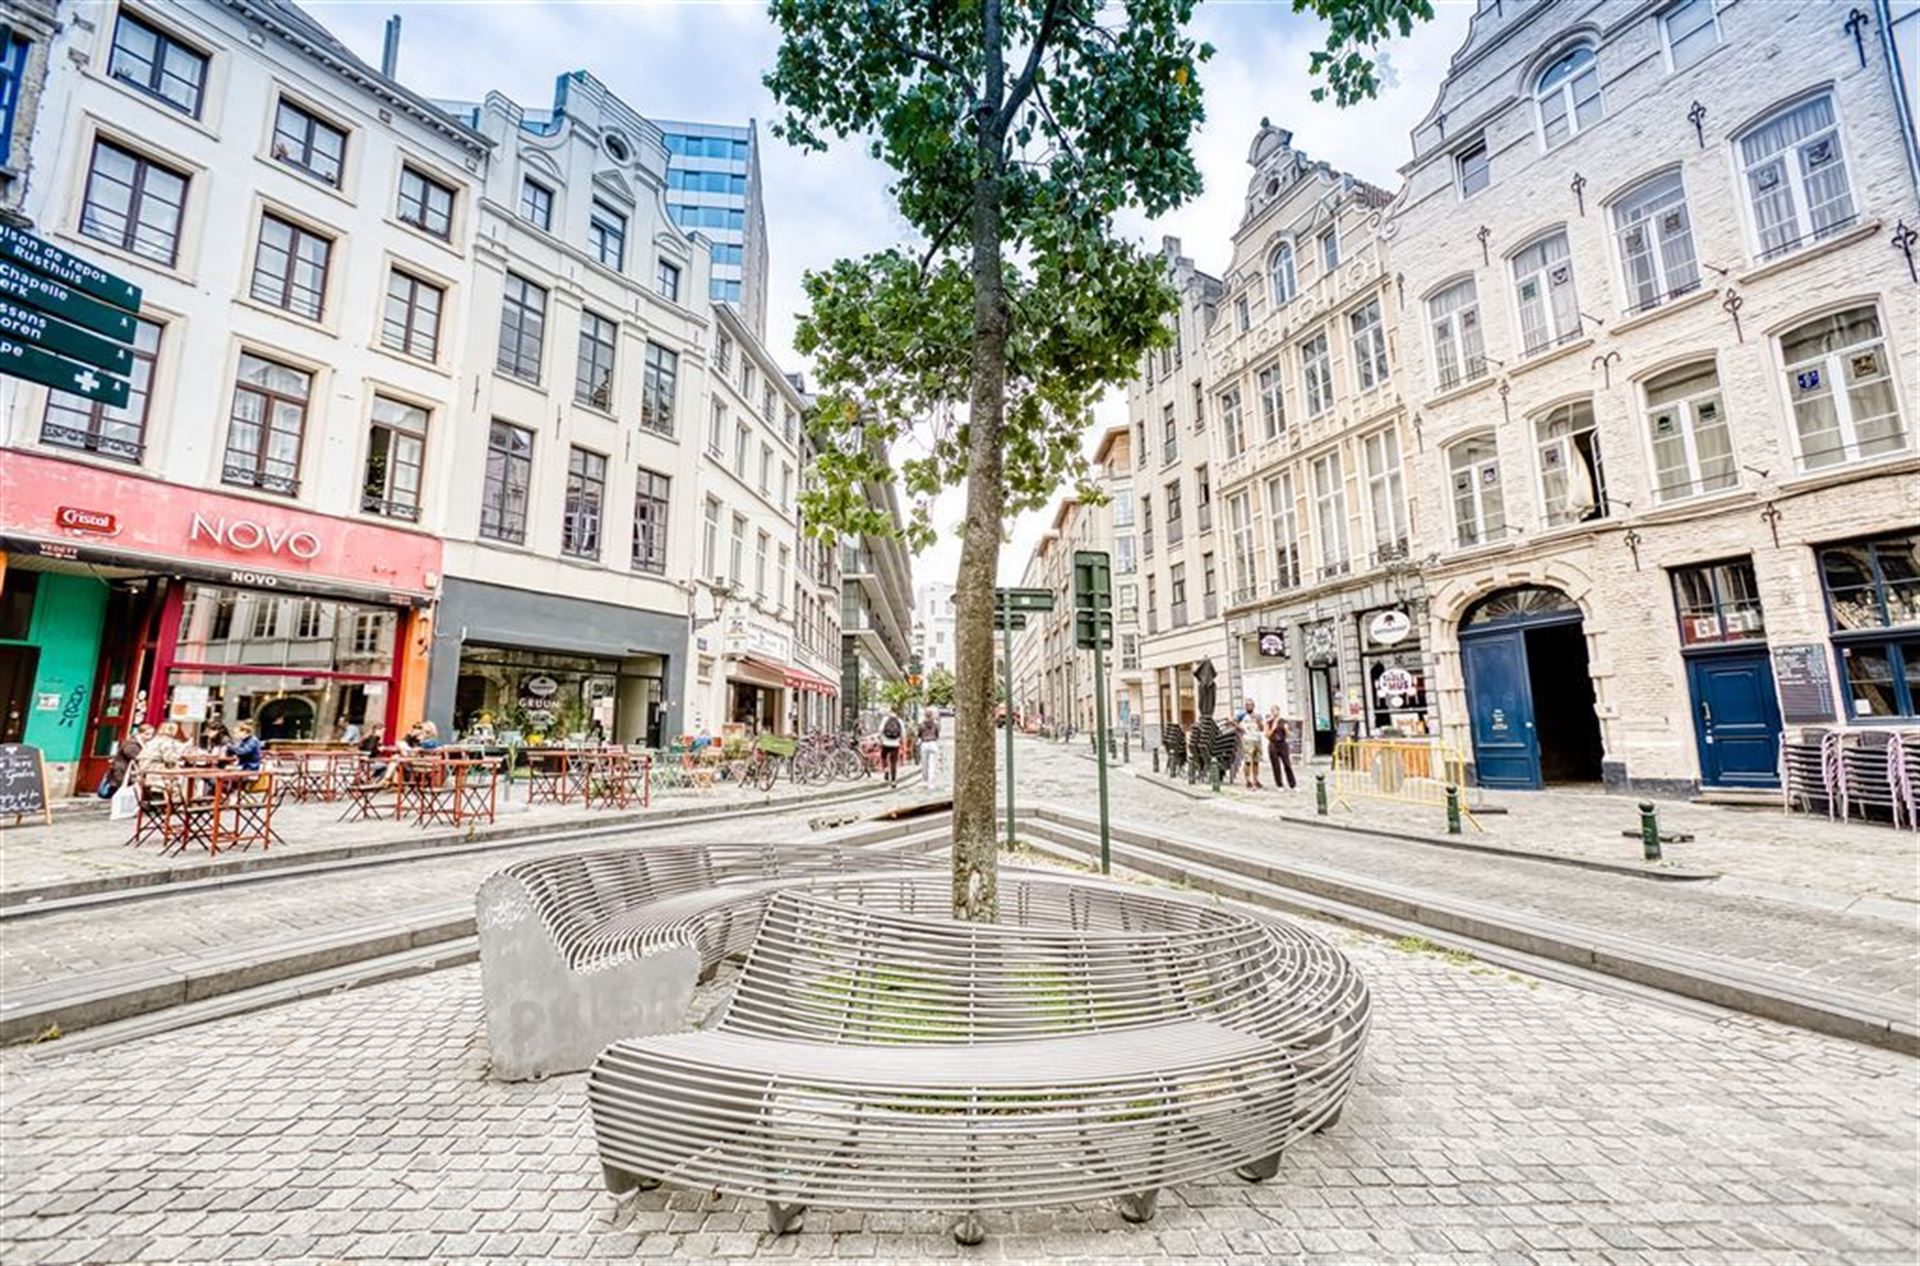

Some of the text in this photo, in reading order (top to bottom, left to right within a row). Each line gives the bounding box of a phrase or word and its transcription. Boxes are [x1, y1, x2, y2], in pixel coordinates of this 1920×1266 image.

[14, 244, 82, 284] Rusthuis
[44, 247, 62, 261] de
[68, 259, 107, 284] repos
[191, 512, 320, 559] NOVO
[231, 571, 277, 587] NOVO
